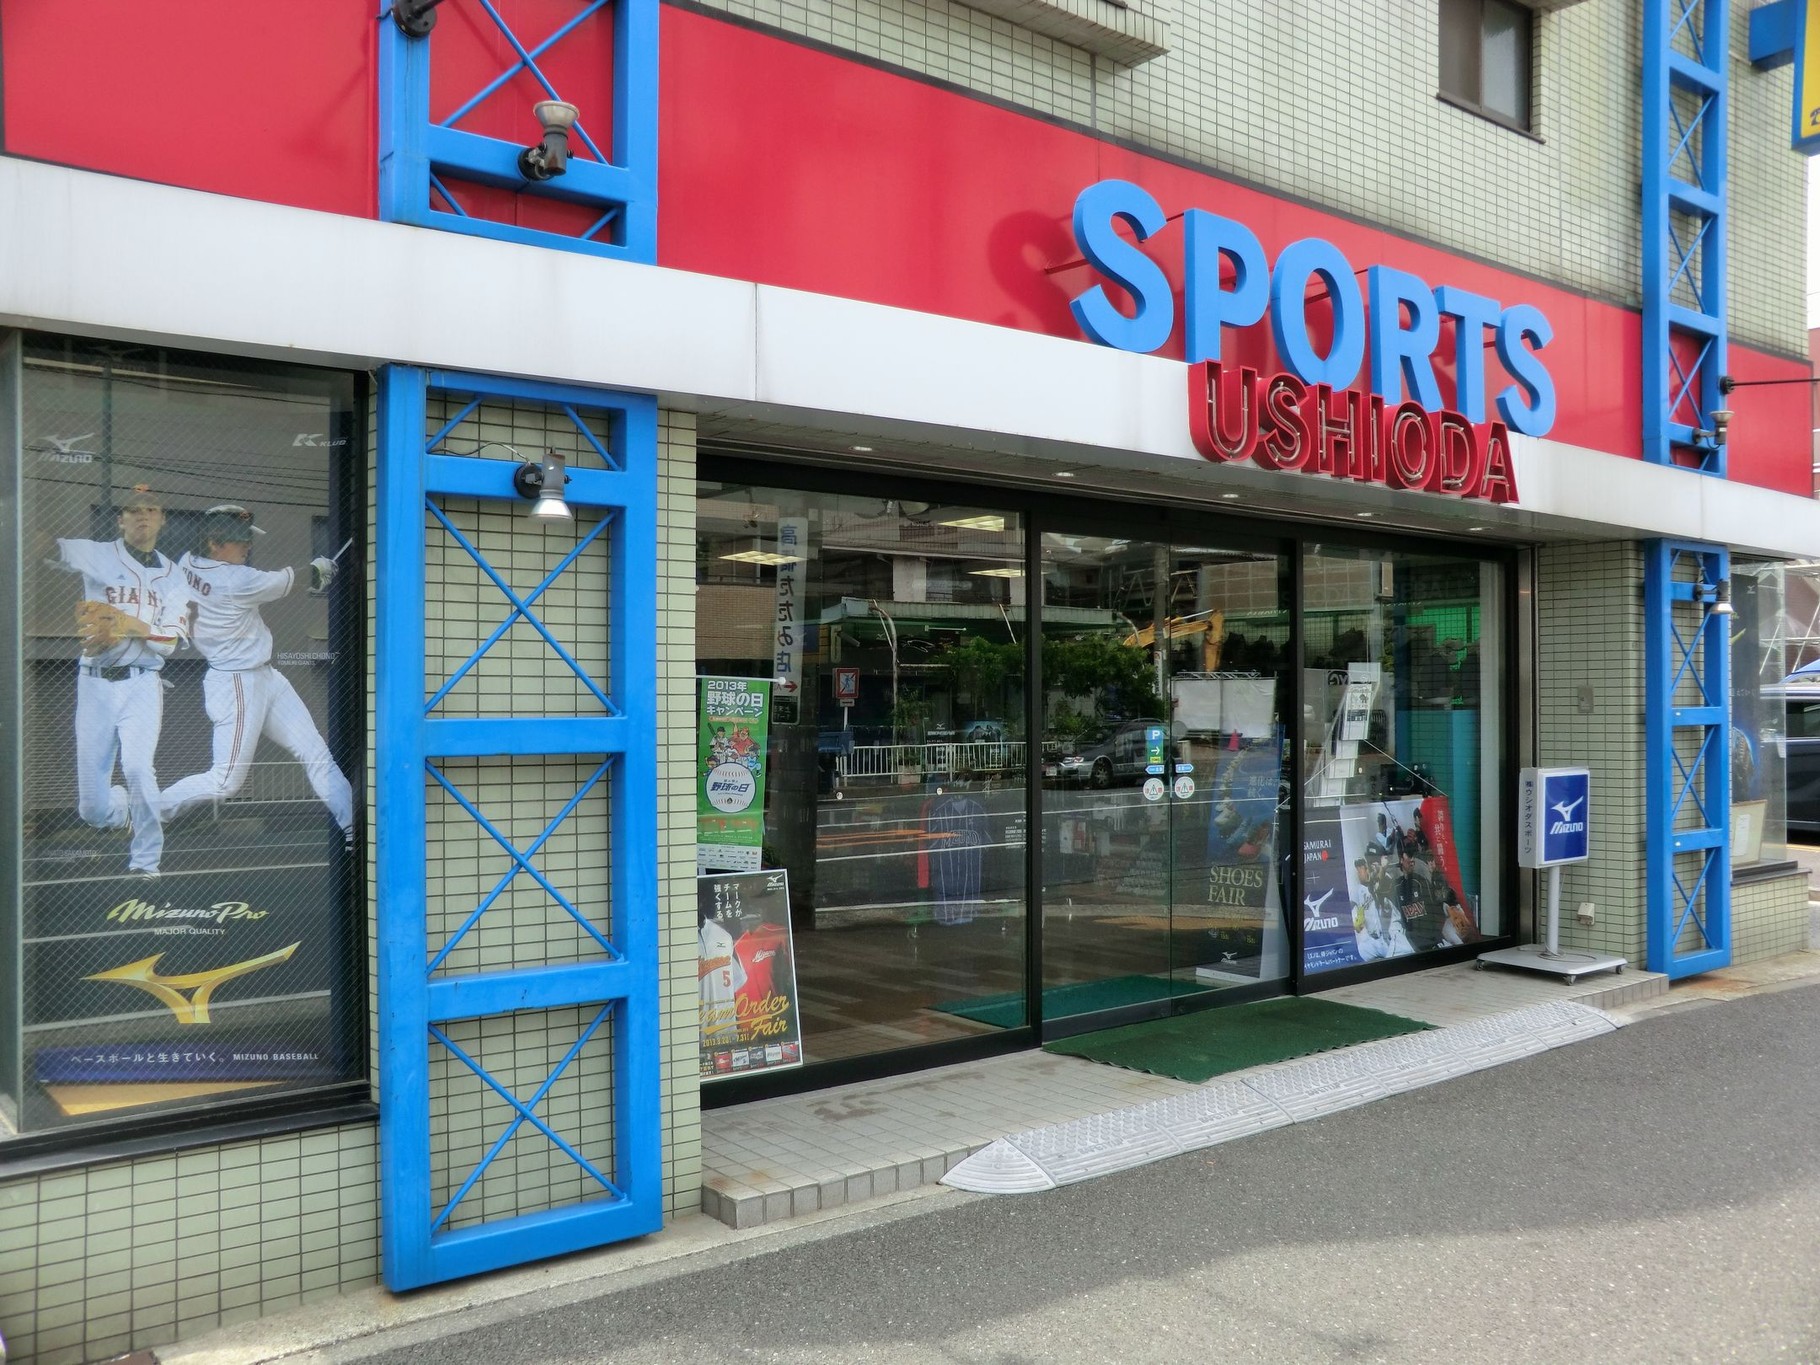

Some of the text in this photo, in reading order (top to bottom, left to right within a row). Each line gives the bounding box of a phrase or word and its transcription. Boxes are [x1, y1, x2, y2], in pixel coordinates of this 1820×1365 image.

[1070, 179, 1556, 437] SPORTS
[1188, 359, 1520, 504] USHIODA
[707, 681, 747, 691] 2013年
[706, 691, 764, 708] 野球の日
[706, 705, 763, 717] キャンペーン
[710, 782, 751, 793] 野球の日
[1550, 821, 1583, 834] MIZUNO
[1304, 839, 1331, 850] SAMURAI
[1304, 853, 1322, 864] JAPAN
[1209, 866, 1263, 888] SHOES
[724, 883, 733, 918] チームを
[733, 883, 742, 917] マークが
[1208, 884, 1246, 906] FAIR
[1304, 917, 1338, 932] MIZUNO
[722, 970, 731, 987] 5
[700, 990, 789, 1024] eam Order
[751, 1017, 787, 1040] Fair
[71, 1052, 319, 1064] ベースボールと生きていく。 MIZUNO BASEBALL
